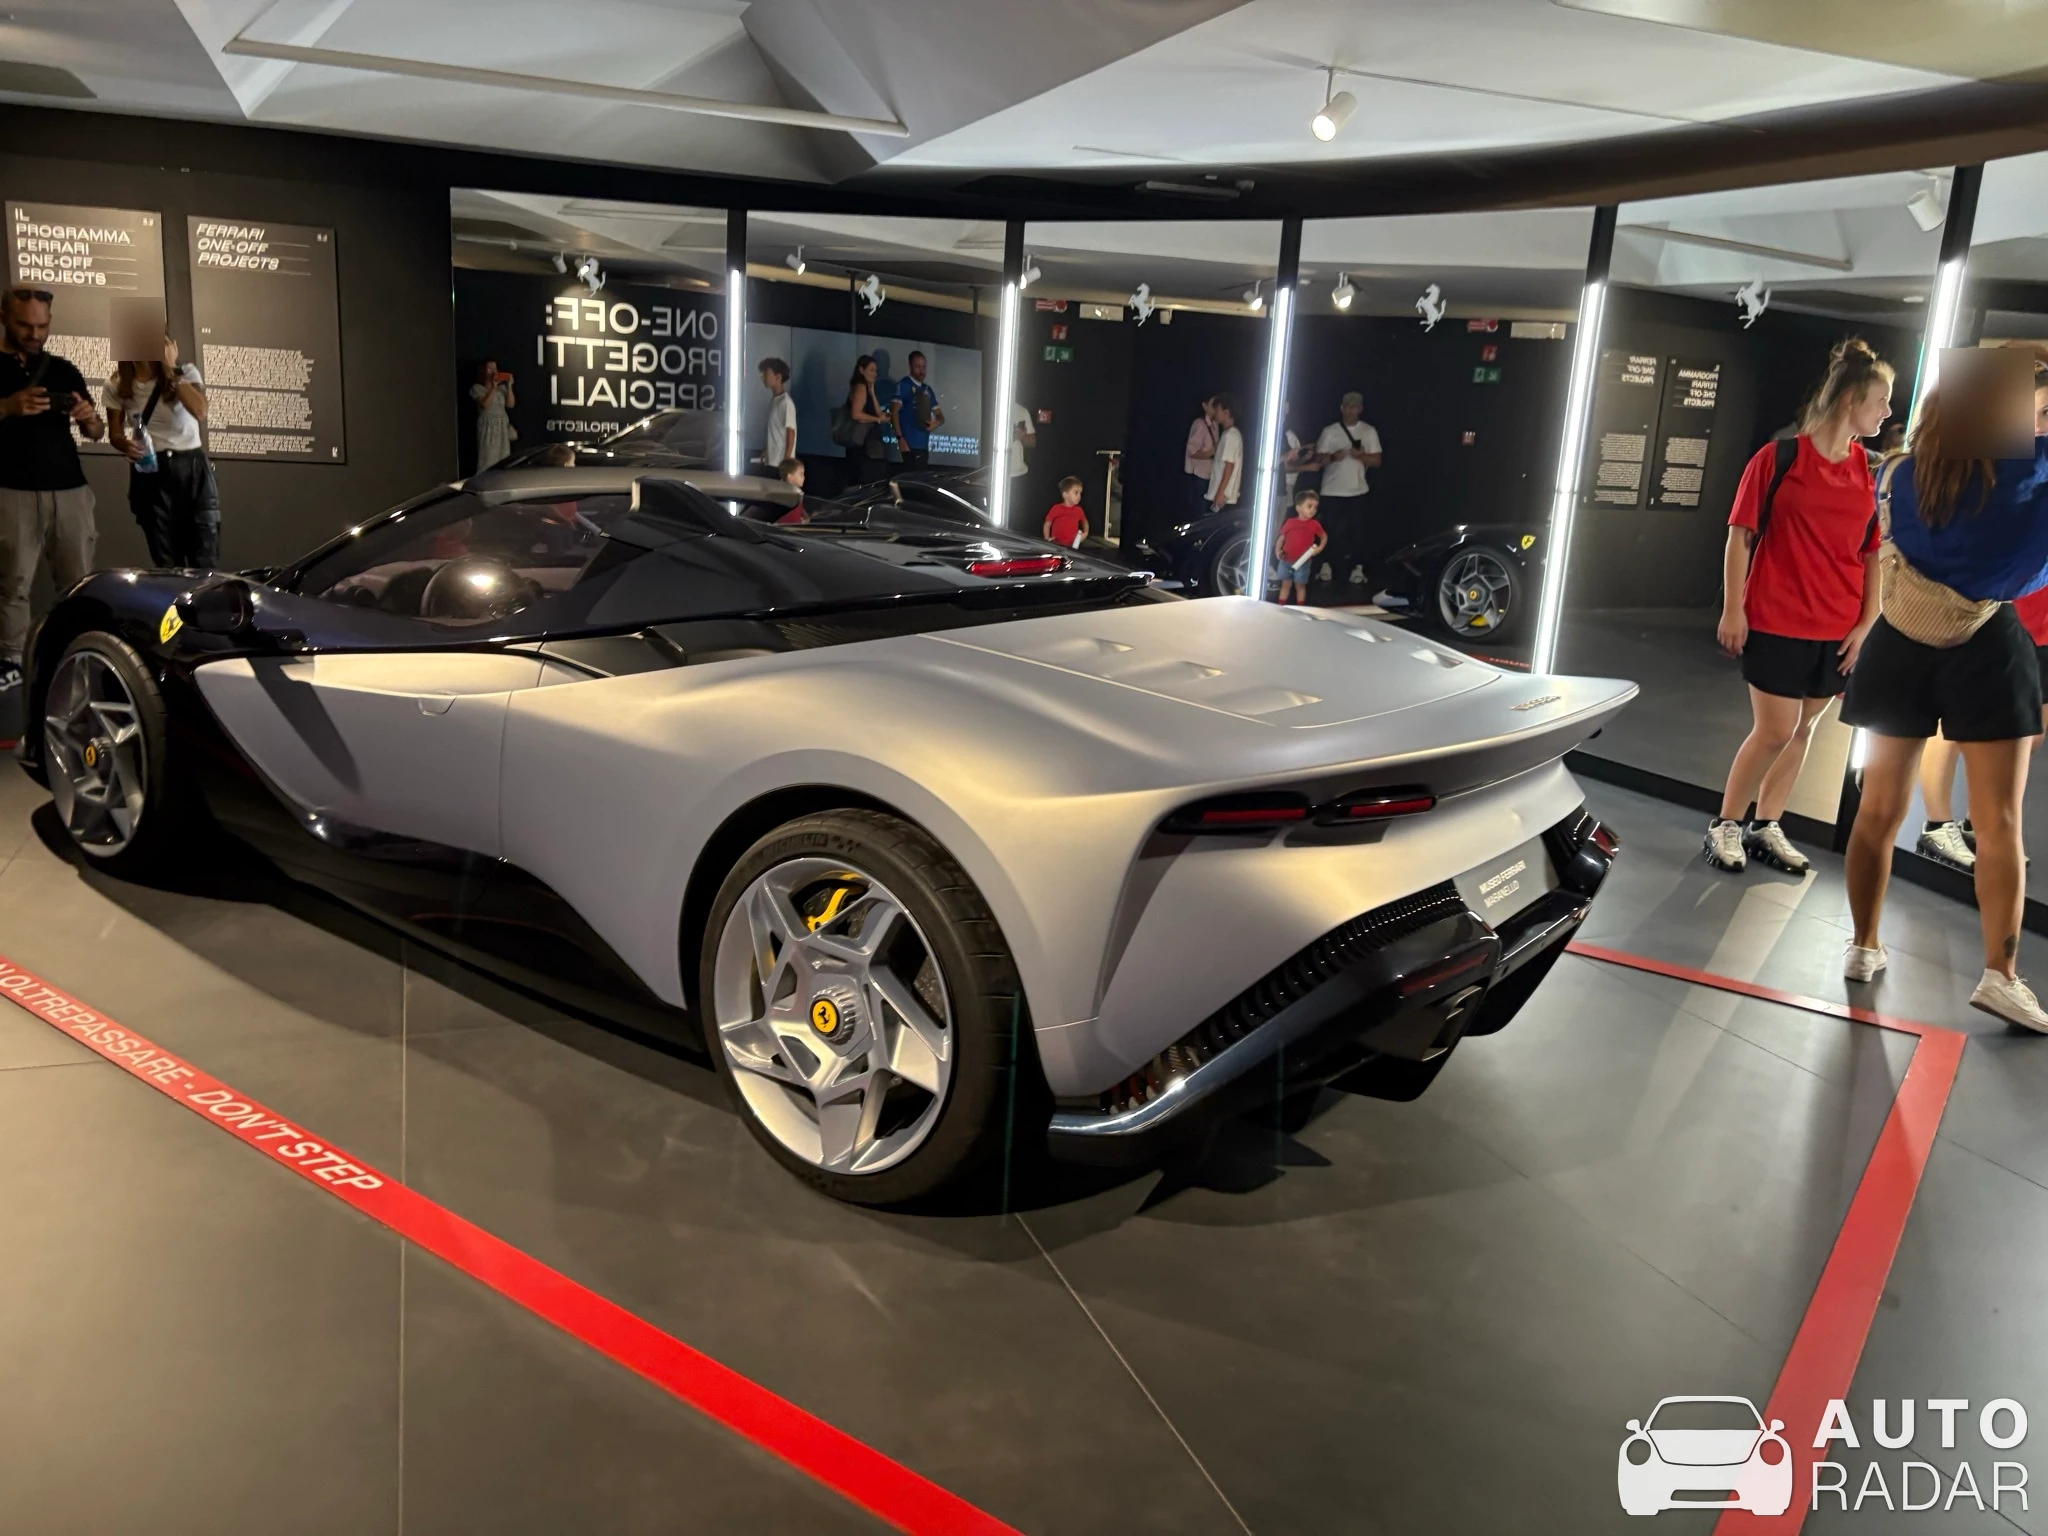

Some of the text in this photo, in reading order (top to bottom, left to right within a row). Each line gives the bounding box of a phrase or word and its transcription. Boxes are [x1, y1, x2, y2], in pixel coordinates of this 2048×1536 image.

[15, 207, 30, 221] IL
[16, 223, 131, 244] PROGRAMMA
[196, 223, 265, 240] FERRARI
[17, 238, 90, 255] FERRARI
[197, 238, 269, 255] ONE-OFF
[18, 252, 93, 270] ONE-OFF
[197, 252, 280, 271] PROJECTS
[19, 267, 107, 286] PROJECTS
[187, 1089, 303, 1141] DON'T
[276, 1139, 385, 1191] STEP
